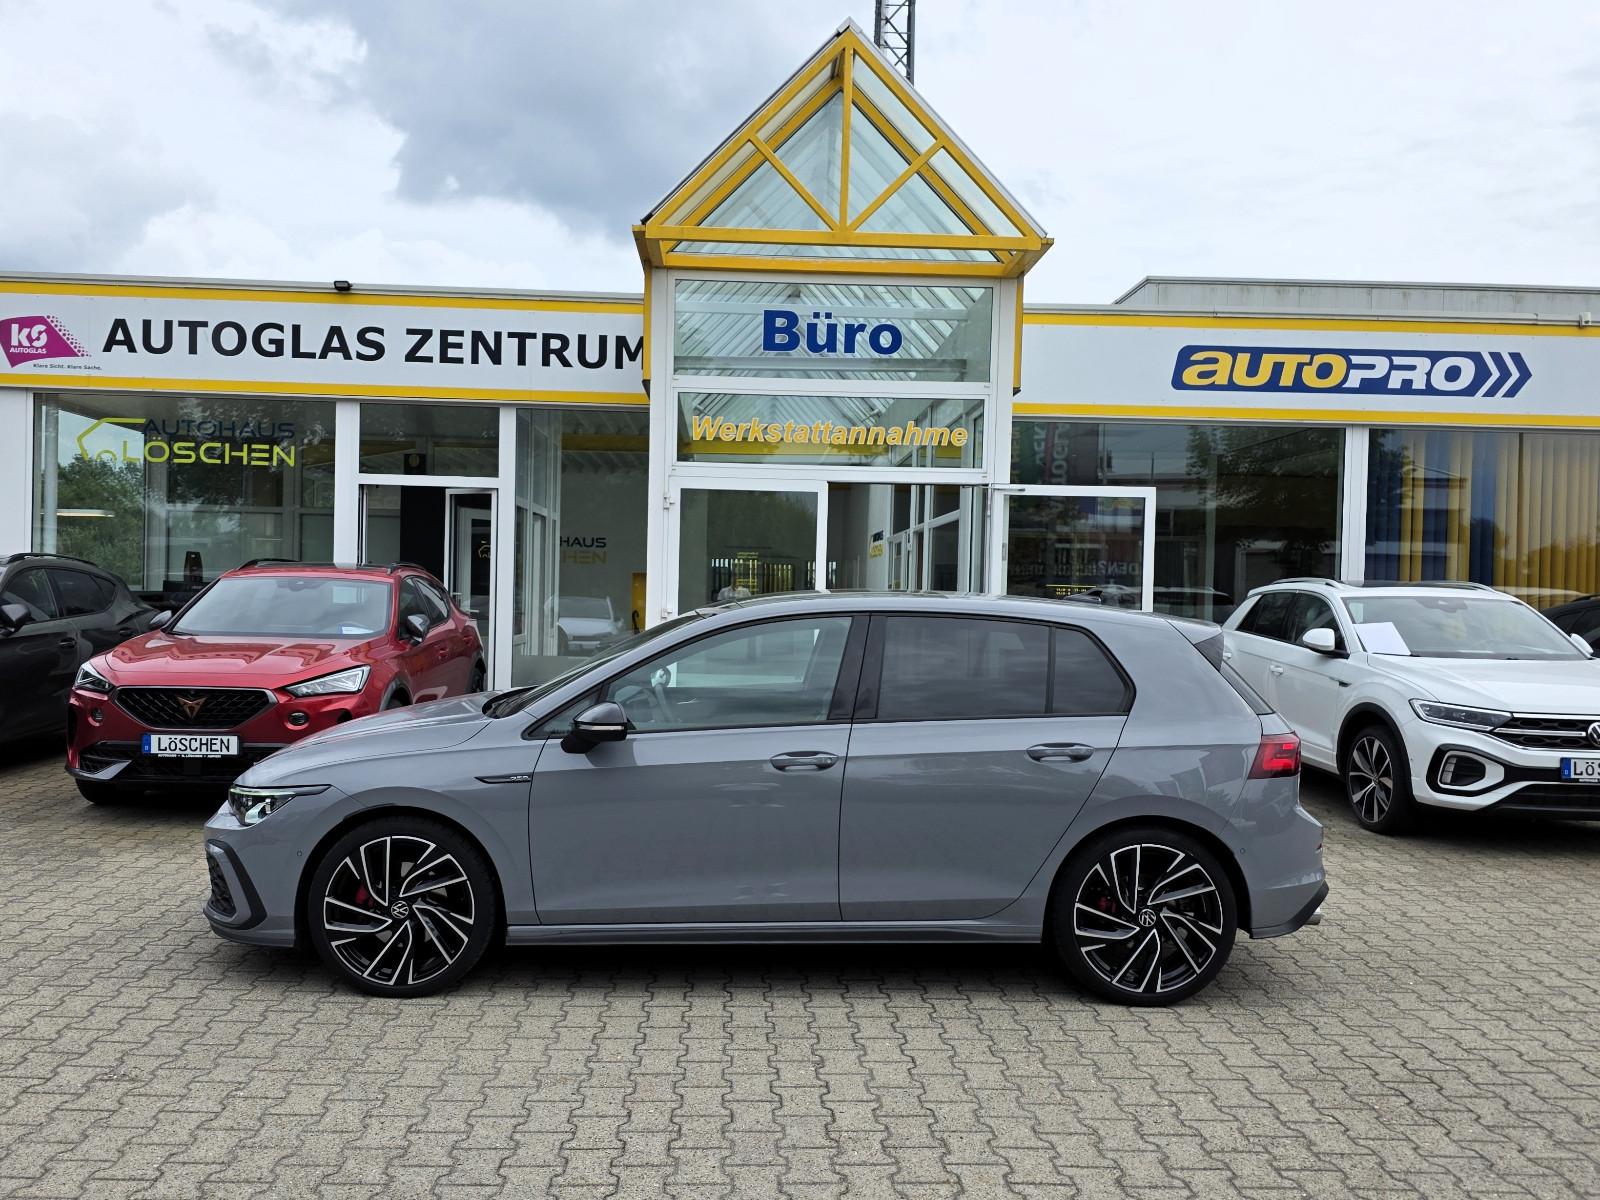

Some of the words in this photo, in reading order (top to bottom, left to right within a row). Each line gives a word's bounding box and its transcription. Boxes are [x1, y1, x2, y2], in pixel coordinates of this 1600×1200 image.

[102, 318, 386, 361] AUTOGLAS
[404, 328, 644, 370] ZENTRUM
[763, 309, 902, 355] Büro
[142, 418, 295, 439] AUTOHAUS
[691, 416, 968, 447] Werkstattannahme
[122, 437, 295, 467] LÖSCHEN
[157, 736, 230, 753] LÖSCHEN
[1573, 760, 1600, 777] LÖ
